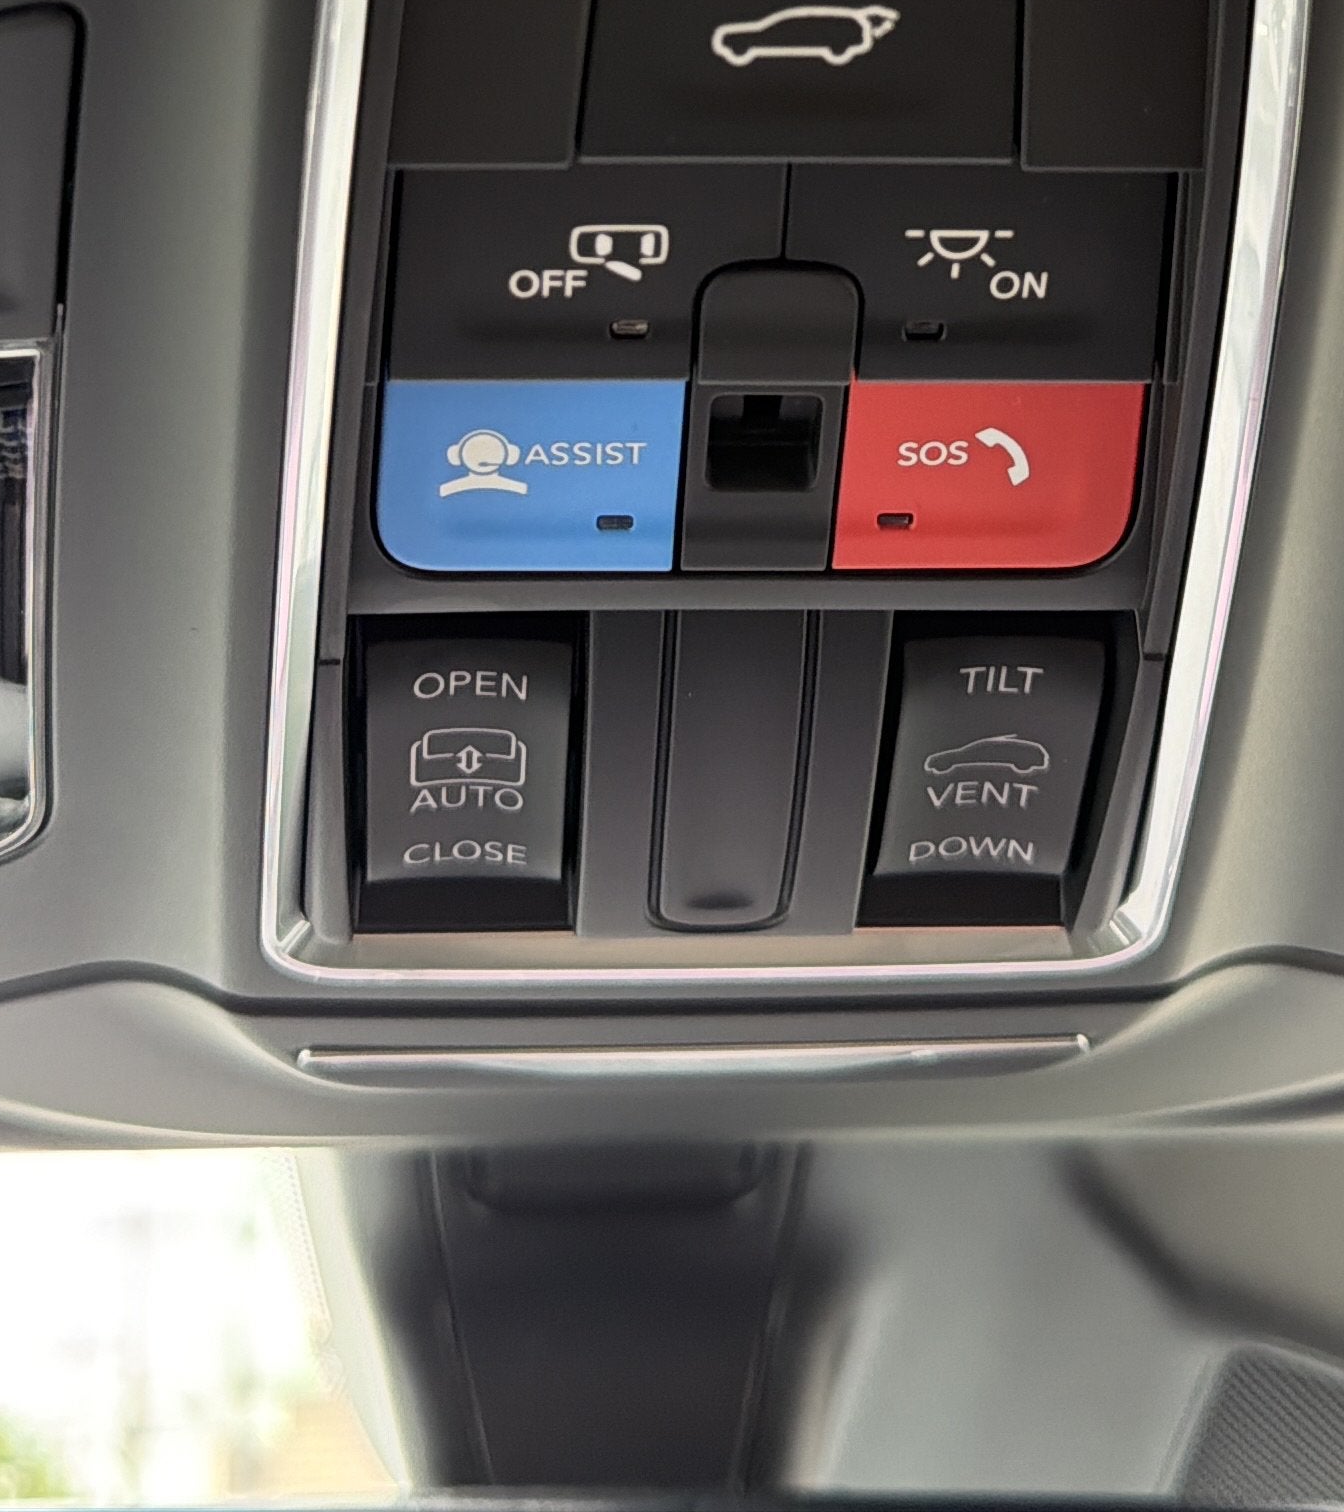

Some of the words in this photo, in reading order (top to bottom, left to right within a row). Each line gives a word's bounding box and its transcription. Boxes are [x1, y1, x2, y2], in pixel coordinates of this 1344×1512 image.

[508, 270, 588, 299] OFF
[989, 270, 1048, 300] ON
[524, 441, 648, 466] ASSIST
[897, 440, 969, 466] SOS
[412, 670, 529, 701] OPEN
[959, 665, 1044, 695] TILT
[410, 785, 524, 813] AUTO
[926, 782, 1039, 810] VENT
[403, 839, 528, 866] CLOSE
[908, 835, 1035, 864] DOWN
